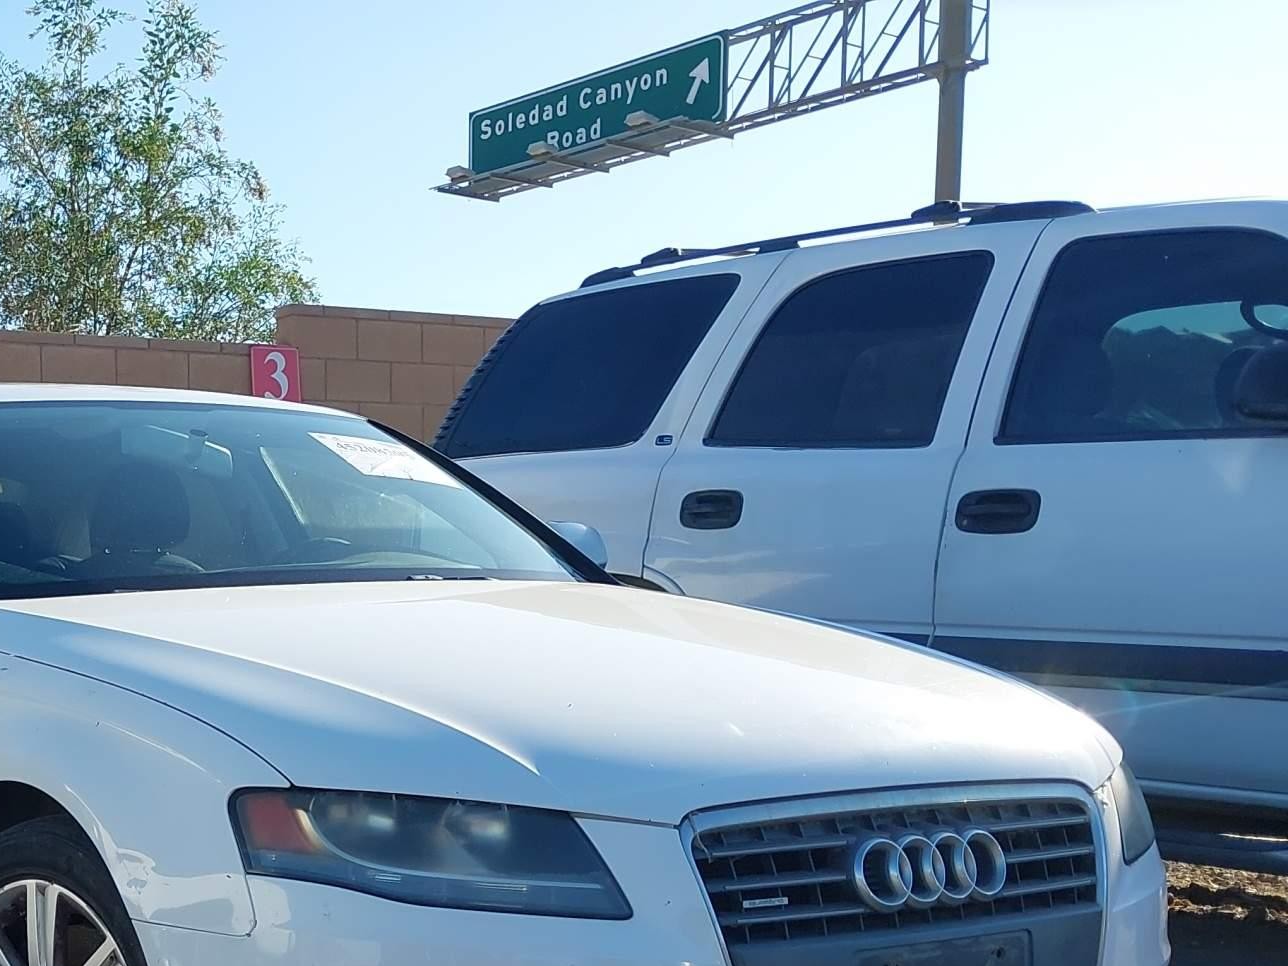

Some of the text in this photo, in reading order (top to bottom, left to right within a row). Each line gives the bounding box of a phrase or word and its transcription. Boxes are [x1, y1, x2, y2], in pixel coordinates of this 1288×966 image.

[479, 67, 668, 140] Soledad Canyon
[546, 117, 602, 149] Road
[263, 351, 289, 400] 3
